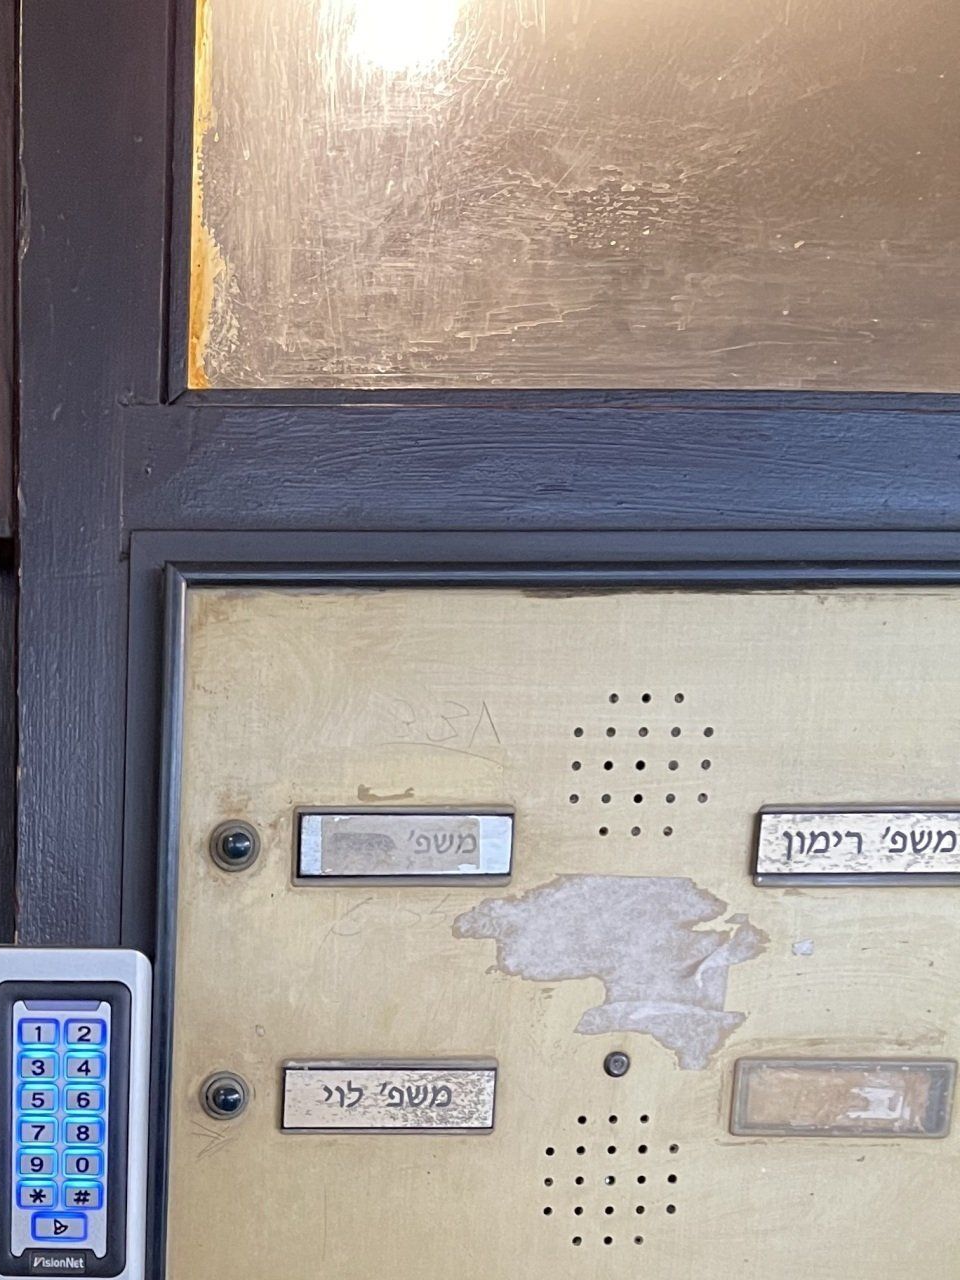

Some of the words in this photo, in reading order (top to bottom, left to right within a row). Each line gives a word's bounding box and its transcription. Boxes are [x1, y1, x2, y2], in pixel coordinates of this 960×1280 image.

[782, 829, 863, 861] רימון
[33, 1025, 42, 1043] 1
[77, 1025, 92, 1042] 2
[31, 1059, 45, 1076] 3
[77, 1059, 91, 1076] 4
[31, 1092, 45, 1109] 5
[76, 1092, 90, 1108] 6
[322, 1079, 364, 1108] לוי
[31, 1125, 46, 1141] 7
[76, 1125, 90, 1141] 8
[30, 1157, 44, 1173] 9
[75, 1157, 89, 1173] 0
[33, 1256, 85, 1269] VisionNet
